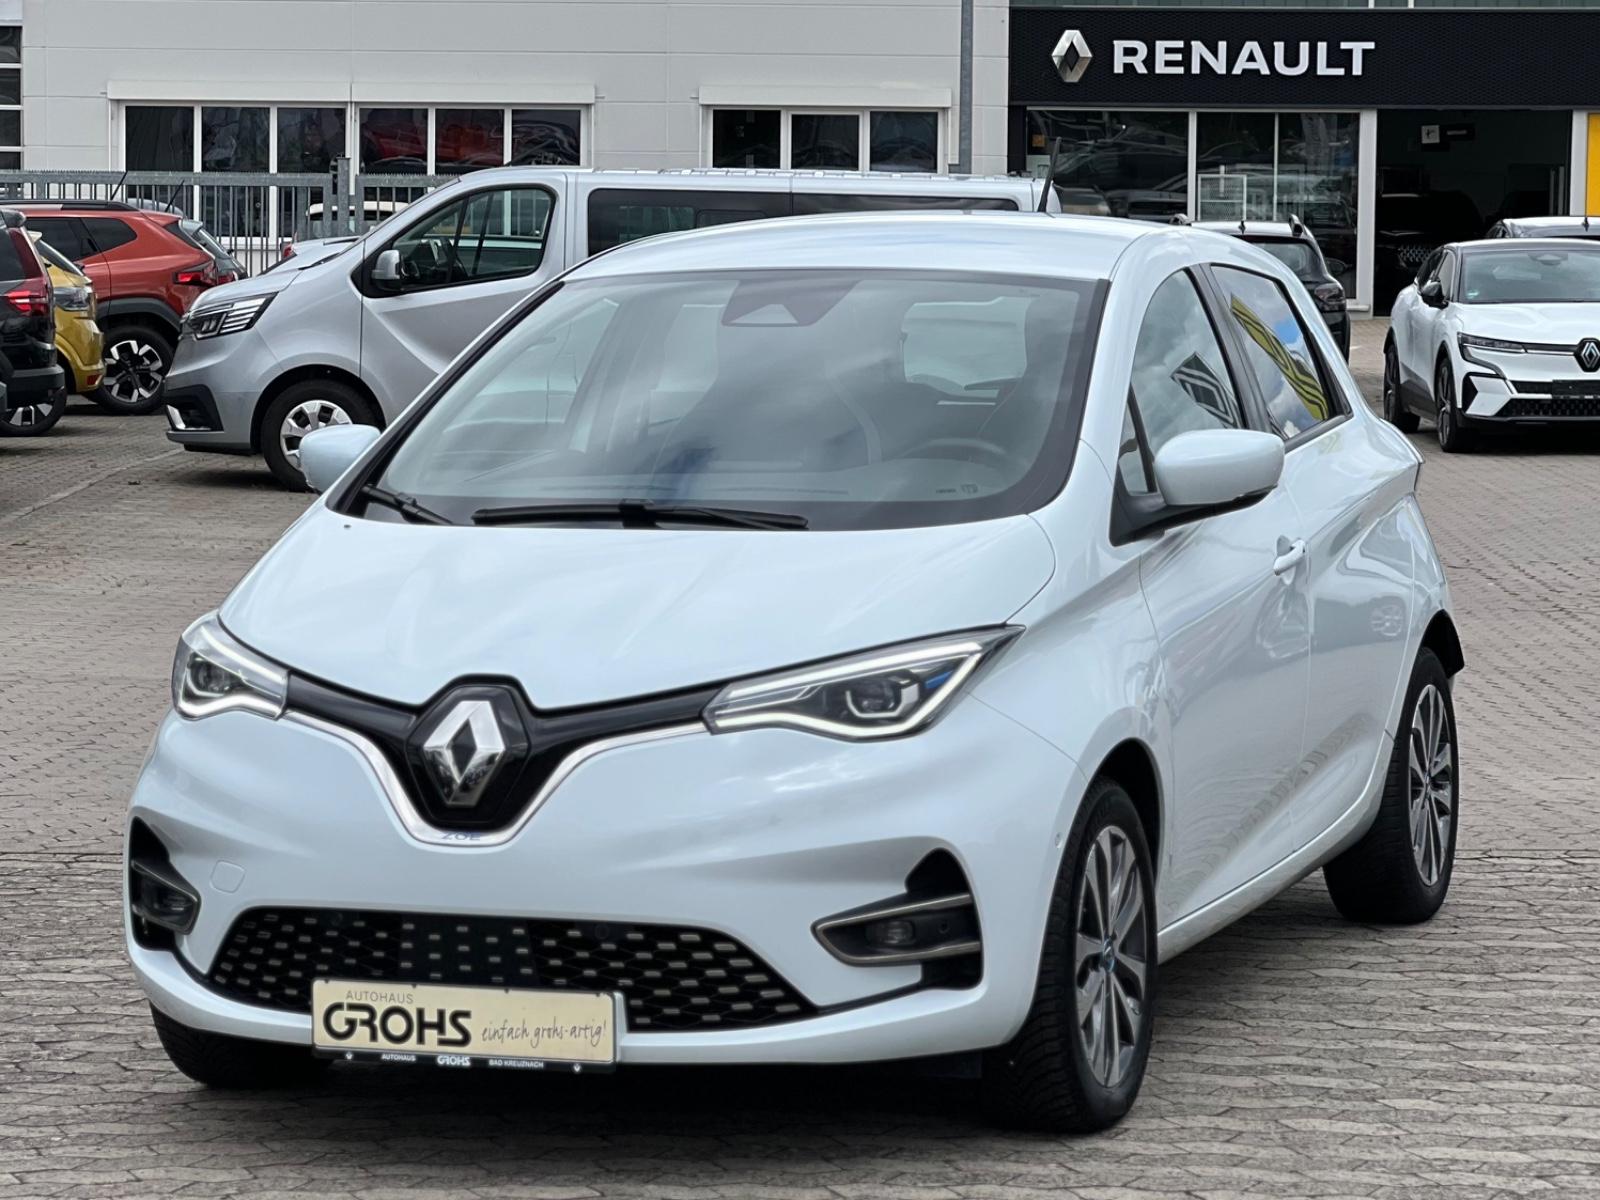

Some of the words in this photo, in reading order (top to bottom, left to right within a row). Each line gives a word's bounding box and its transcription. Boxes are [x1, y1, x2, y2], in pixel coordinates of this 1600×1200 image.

[1113, 40, 1376, 76] RENAULT
[345, 990, 415, 1005] AUTOHAUS
[323, 1002, 472, 1047] GROHS
[481, 1018, 530, 1044] einfach
[381, 1053, 416, 1062] AUTOHAUS
[437, 1055, 471, 1067] GROHS
[489, 1059, 503, 1067] BAD
[504, 1060, 544, 1069] KREUZNACH
